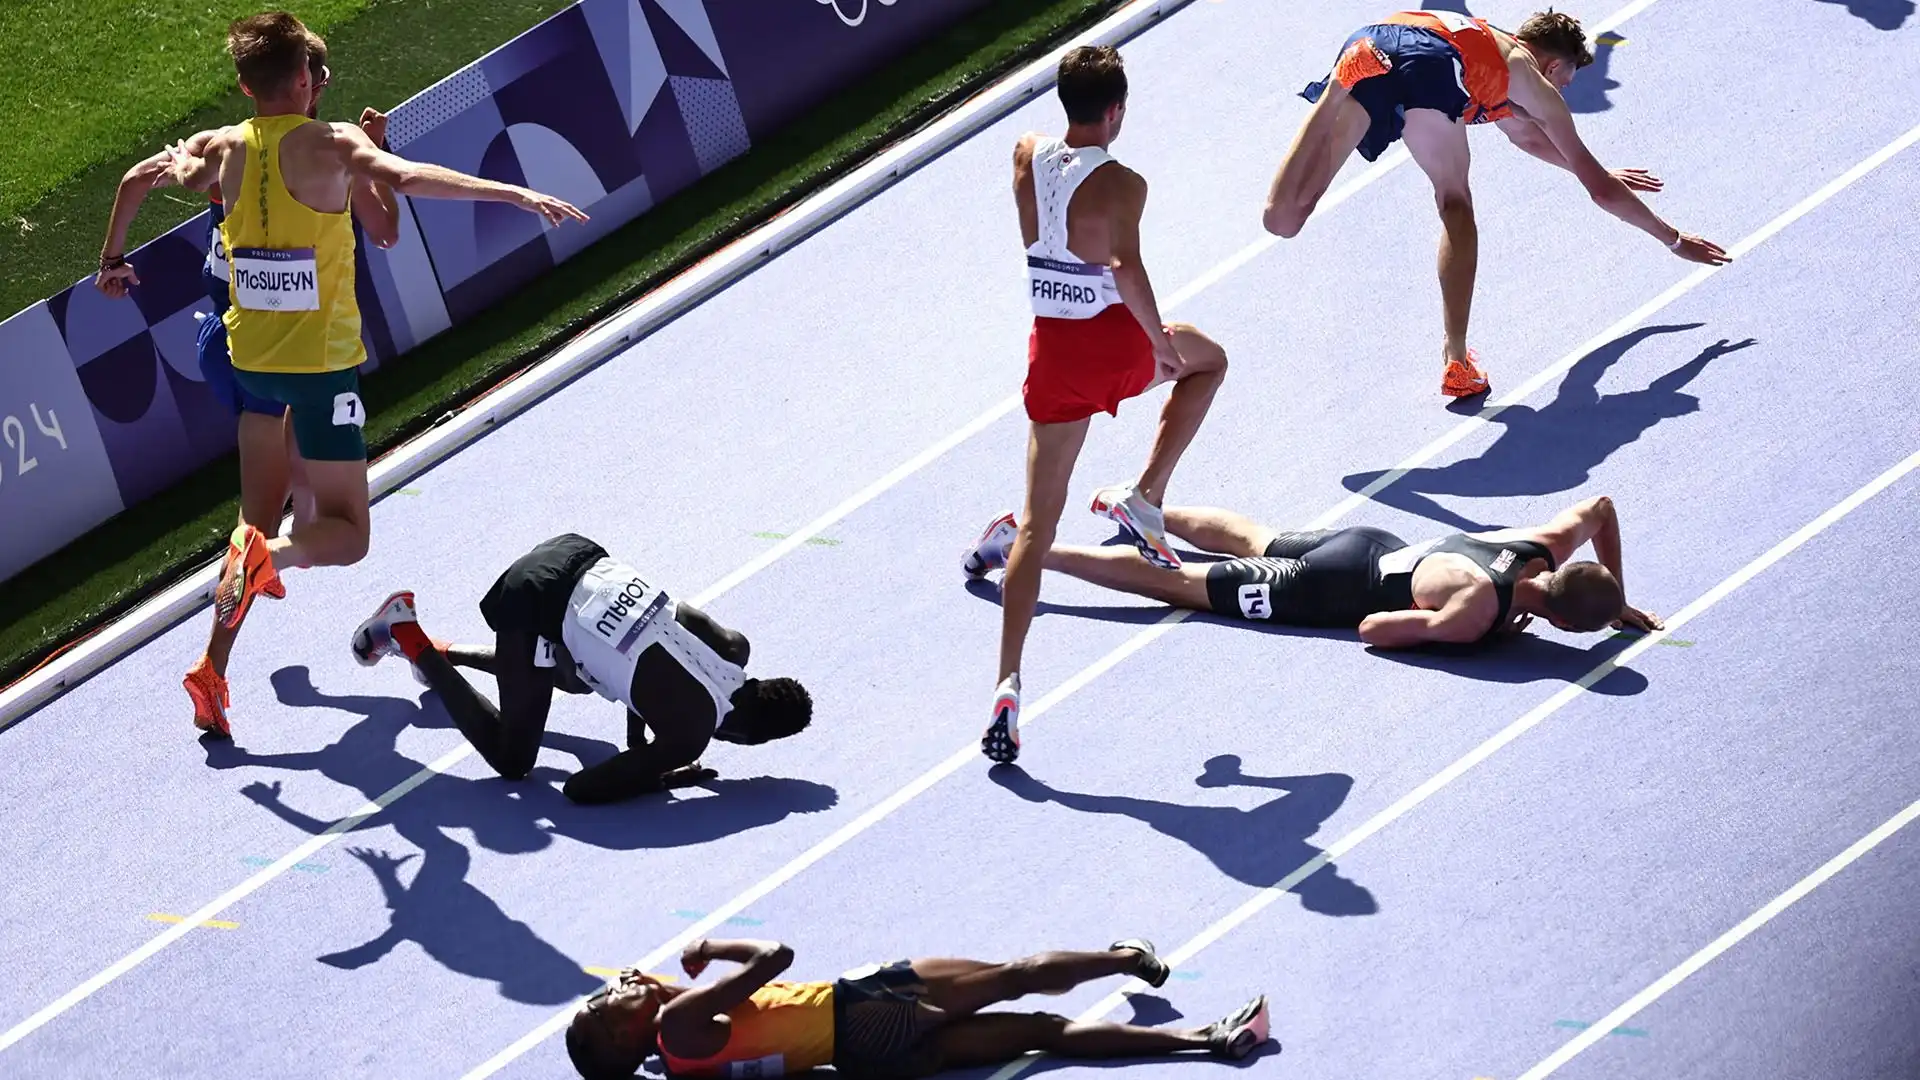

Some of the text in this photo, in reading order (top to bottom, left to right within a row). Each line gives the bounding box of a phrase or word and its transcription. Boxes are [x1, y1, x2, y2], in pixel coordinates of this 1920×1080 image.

[236, 268, 314, 292] McSWEYN
[1032, 279, 1097, 304] FAFARD
[346, 398, 356, 418] 1
[0, 403, 68, 488] 24
[596, 577, 650, 638] LOBALU
[1244, 589, 1264, 615] 14
